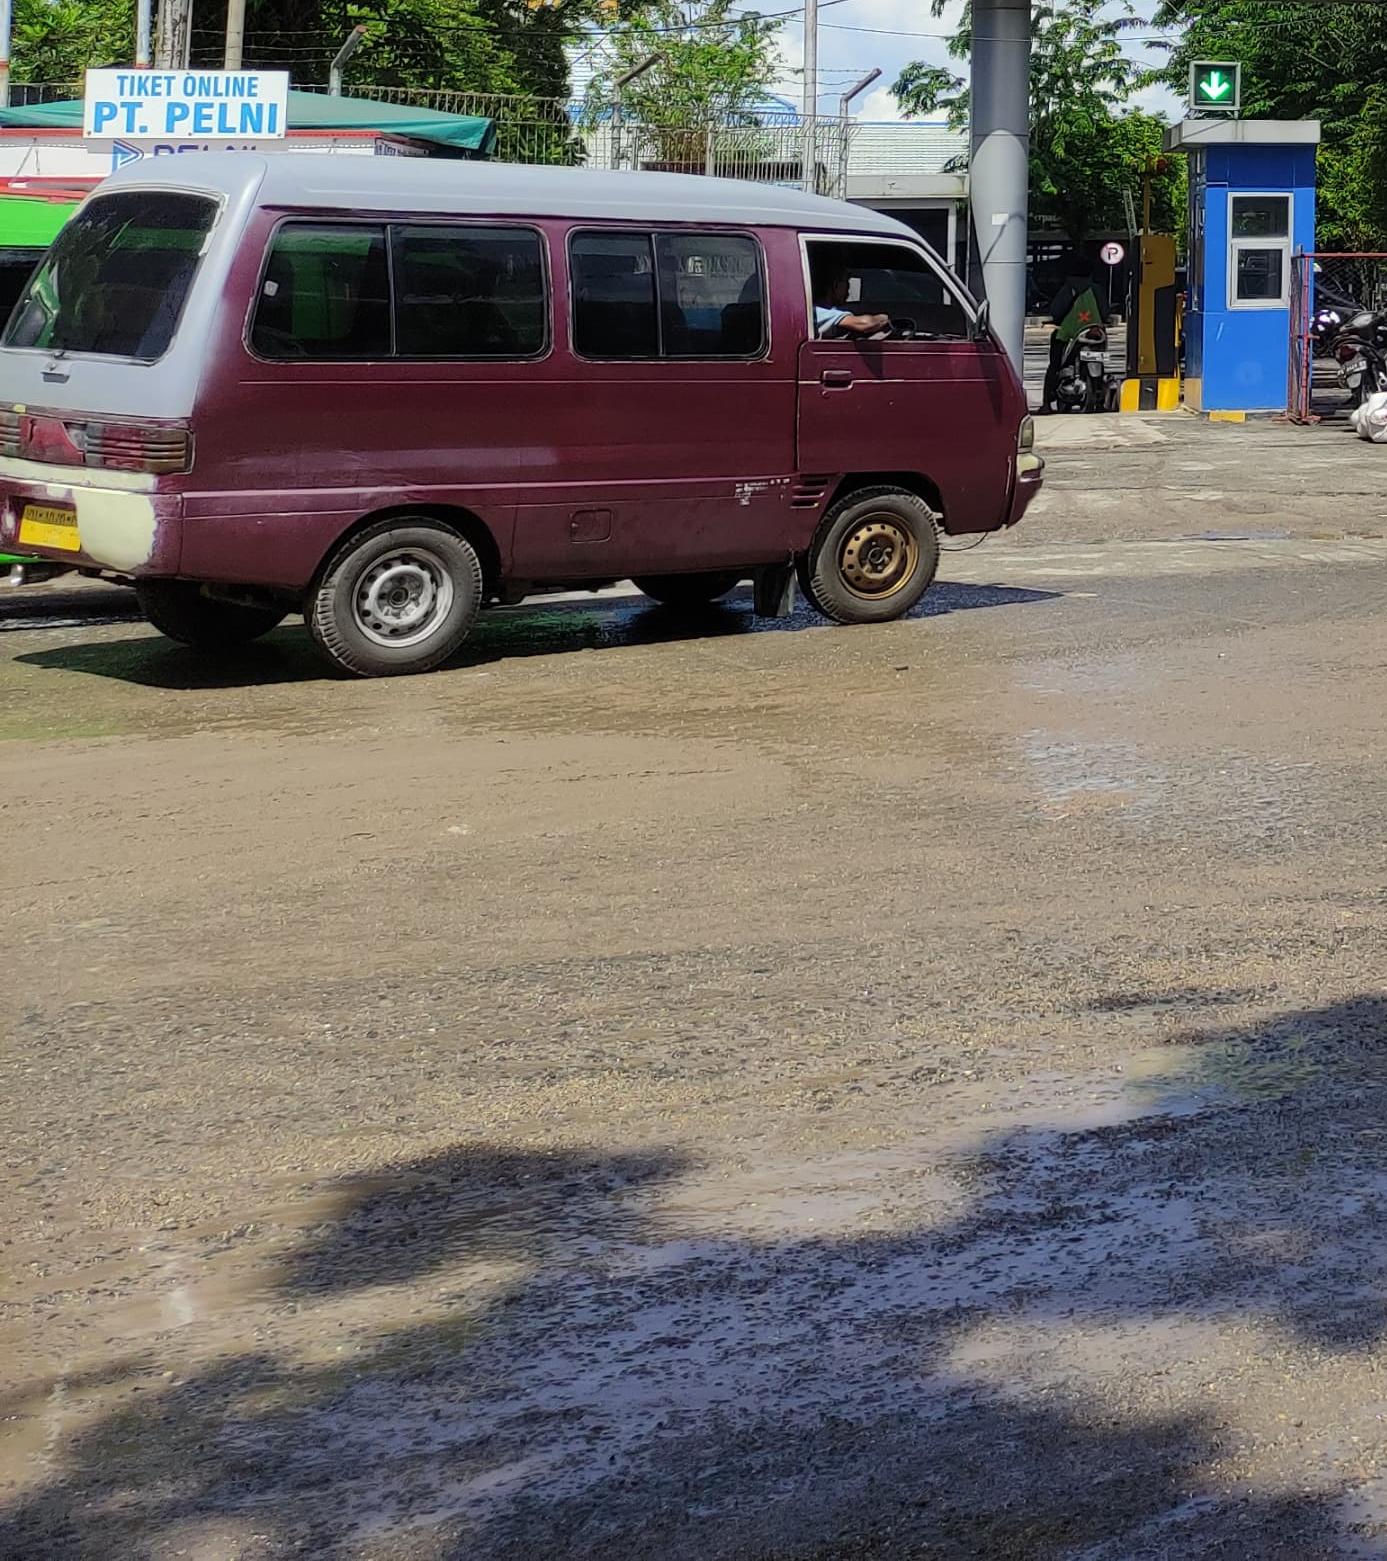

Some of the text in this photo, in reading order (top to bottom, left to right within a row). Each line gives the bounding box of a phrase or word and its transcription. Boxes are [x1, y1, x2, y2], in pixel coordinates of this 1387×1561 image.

[116, 75, 259, 98] TIKET ONLINE
[94, 101, 278, 134] PT. PELNI
